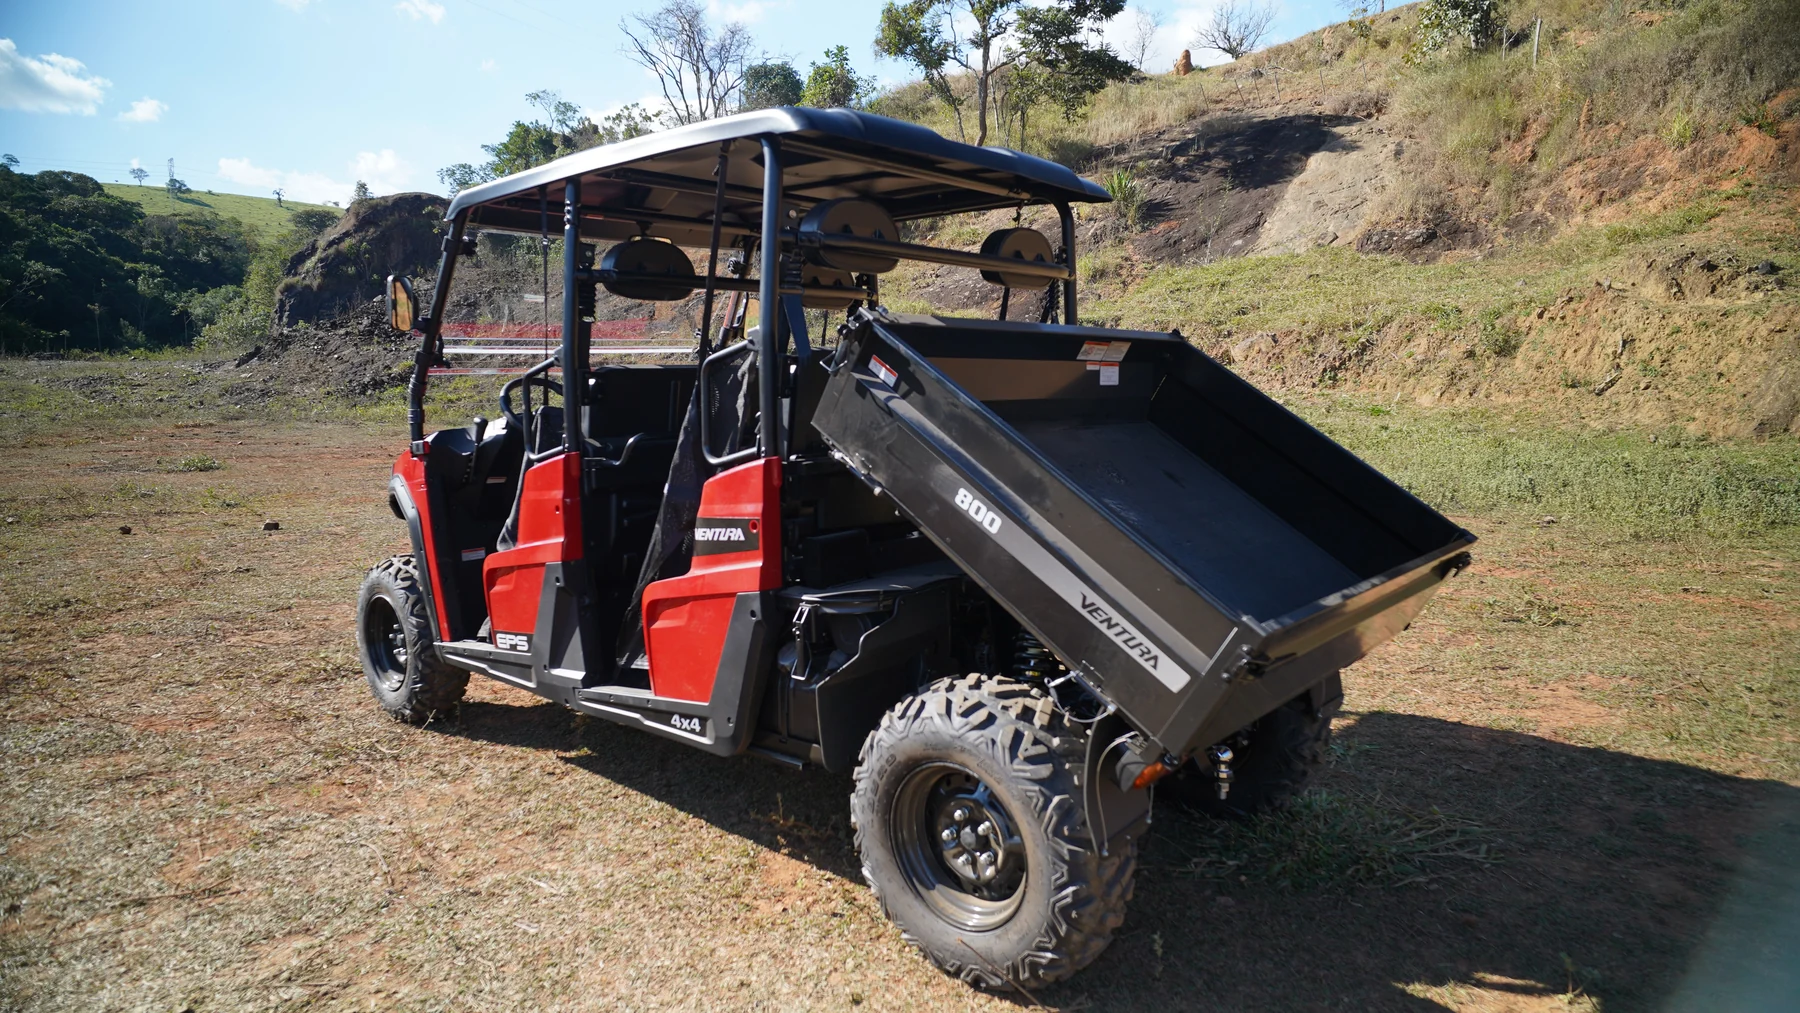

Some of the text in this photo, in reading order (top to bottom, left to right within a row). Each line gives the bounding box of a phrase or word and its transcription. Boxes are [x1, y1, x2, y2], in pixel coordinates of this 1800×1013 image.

[954, 487, 1003, 535] 800
[496, 633, 529, 651] EPS
[1080, 591, 1159, 671] VENTURA
[670, 713, 702, 733] 4x4
